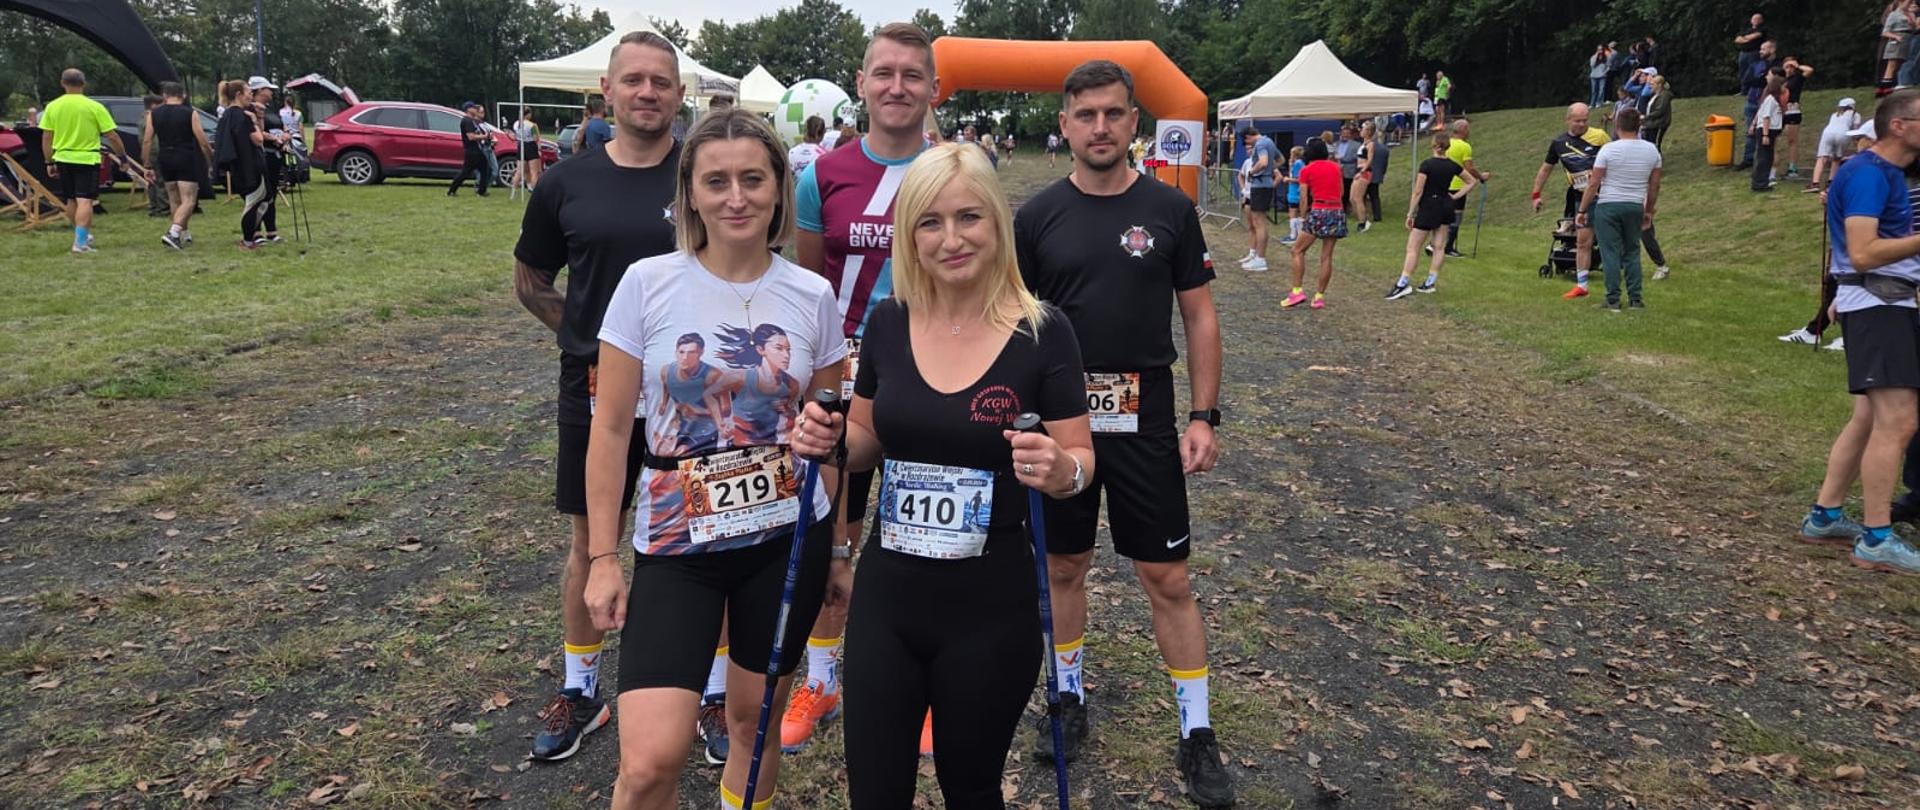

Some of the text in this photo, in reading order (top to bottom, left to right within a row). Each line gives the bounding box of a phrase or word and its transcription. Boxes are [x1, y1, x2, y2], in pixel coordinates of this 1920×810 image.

[849, 222, 895, 237] NEVE
[849, 235, 890, 248] GIVE
[981, 398, 1012, 408] KGW
[1088, 393, 1114, 411] 06
[970, 412, 1003, 425] Nowej
[714, 474, 770, 508] 219
[900, 493, 956, 525] 410
